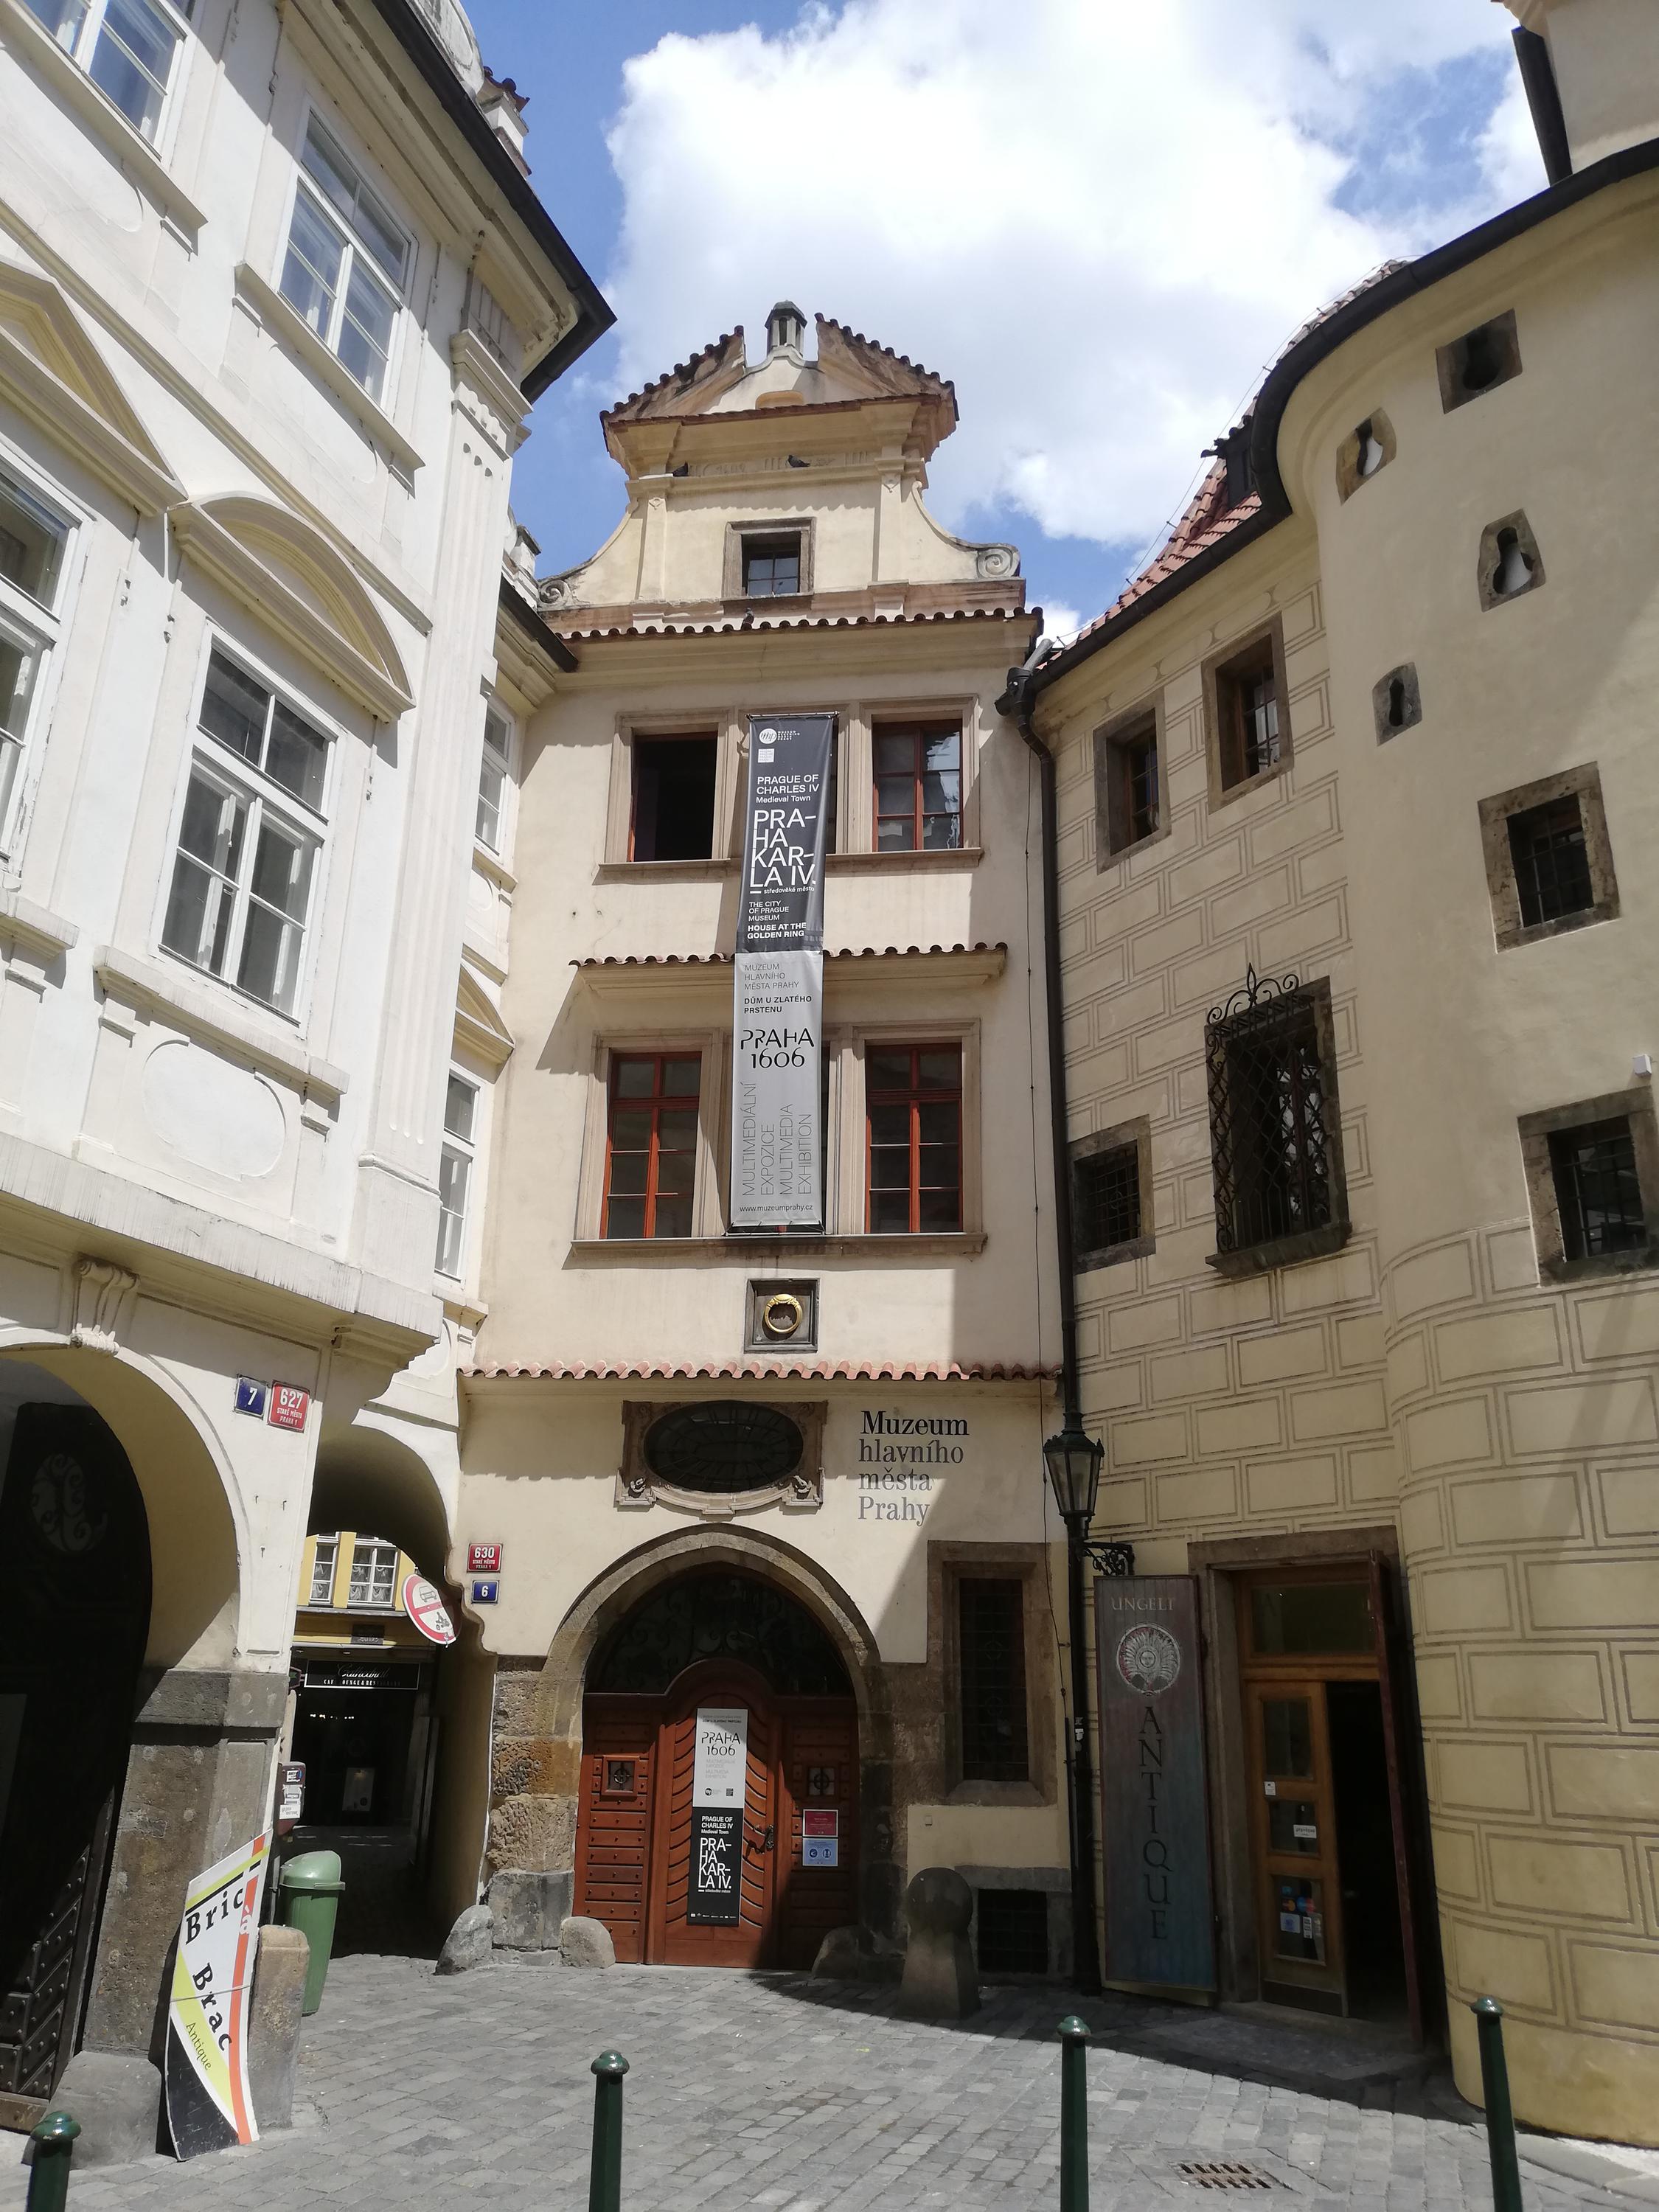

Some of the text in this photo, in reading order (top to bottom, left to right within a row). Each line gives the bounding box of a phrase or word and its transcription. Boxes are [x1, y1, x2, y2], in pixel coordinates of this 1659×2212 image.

[757, 774, 819, 785] PRAGUE OF
[757, 784, 819, 795] CHARLES IV
[754, 808, 816, 830] PRA-
[753, 827, 788, 848] HA
[751, 846, 814, 868] KAR-
[750, 863, 816, 887] LA IV.
[748, 924, 776, 932] HOUSE
[745, 963, 779, 971] MUZEUM
[745, 972, 785, 981] HLAVNÍHO
[745, 982, 770, 990] MĚSTA
[744, 996, 763, 1004] DŮM
[774, 995, 812, 1003] ZLATÉHO
[744, 1006, 782, 1014] PRSTENU
[740, 1028, 815, 1050] PRAHA
[751, 1047, 805, 1068] 1606
[740, 1082, 757, 1196] MULTIMEDIÁLNÍ
[779, 1104, 793, 1194] MULTIMEDIA
[761, 1124, 774, 1195] EXPOZICE
[799, 1114, 811, 1194] EXHIBITION
[740, 1204, 813, 1212] www.muzeumprahy.cz
[247, 1386, 258, 1405] 7
[280, 1388, 303, 1409] 627
[860, 1411, 970, 1435] Muzeum
[858, 1439, 964, 1464] hlavního
[858, 1467, 932, 1491] města
[858, 1496, 931, 1526] Prahy
[474, 1547, 495, 1559] 630
[481, 1585, 488, 1597] 6
[1111, 1597, 1176, 1611] UNGELT
[701, 1731, 740, 1745] PRAHA
[707, 1744, 735, 1756] 1606
[1138, 1705, 1175, 1940] ANTIQUE
[700, 1837, 731, 1851] PRA-
[700, 1850, 717, 1864] HA
[699, 1863, 731, 1877] KAR-
[698, 1875, 732, 1889] LA IV.
[185, 1888, 243, 1945] Bric
[192, 1962, 232, 2051] Brac
[186, 2023, 212, 2071] Antique
